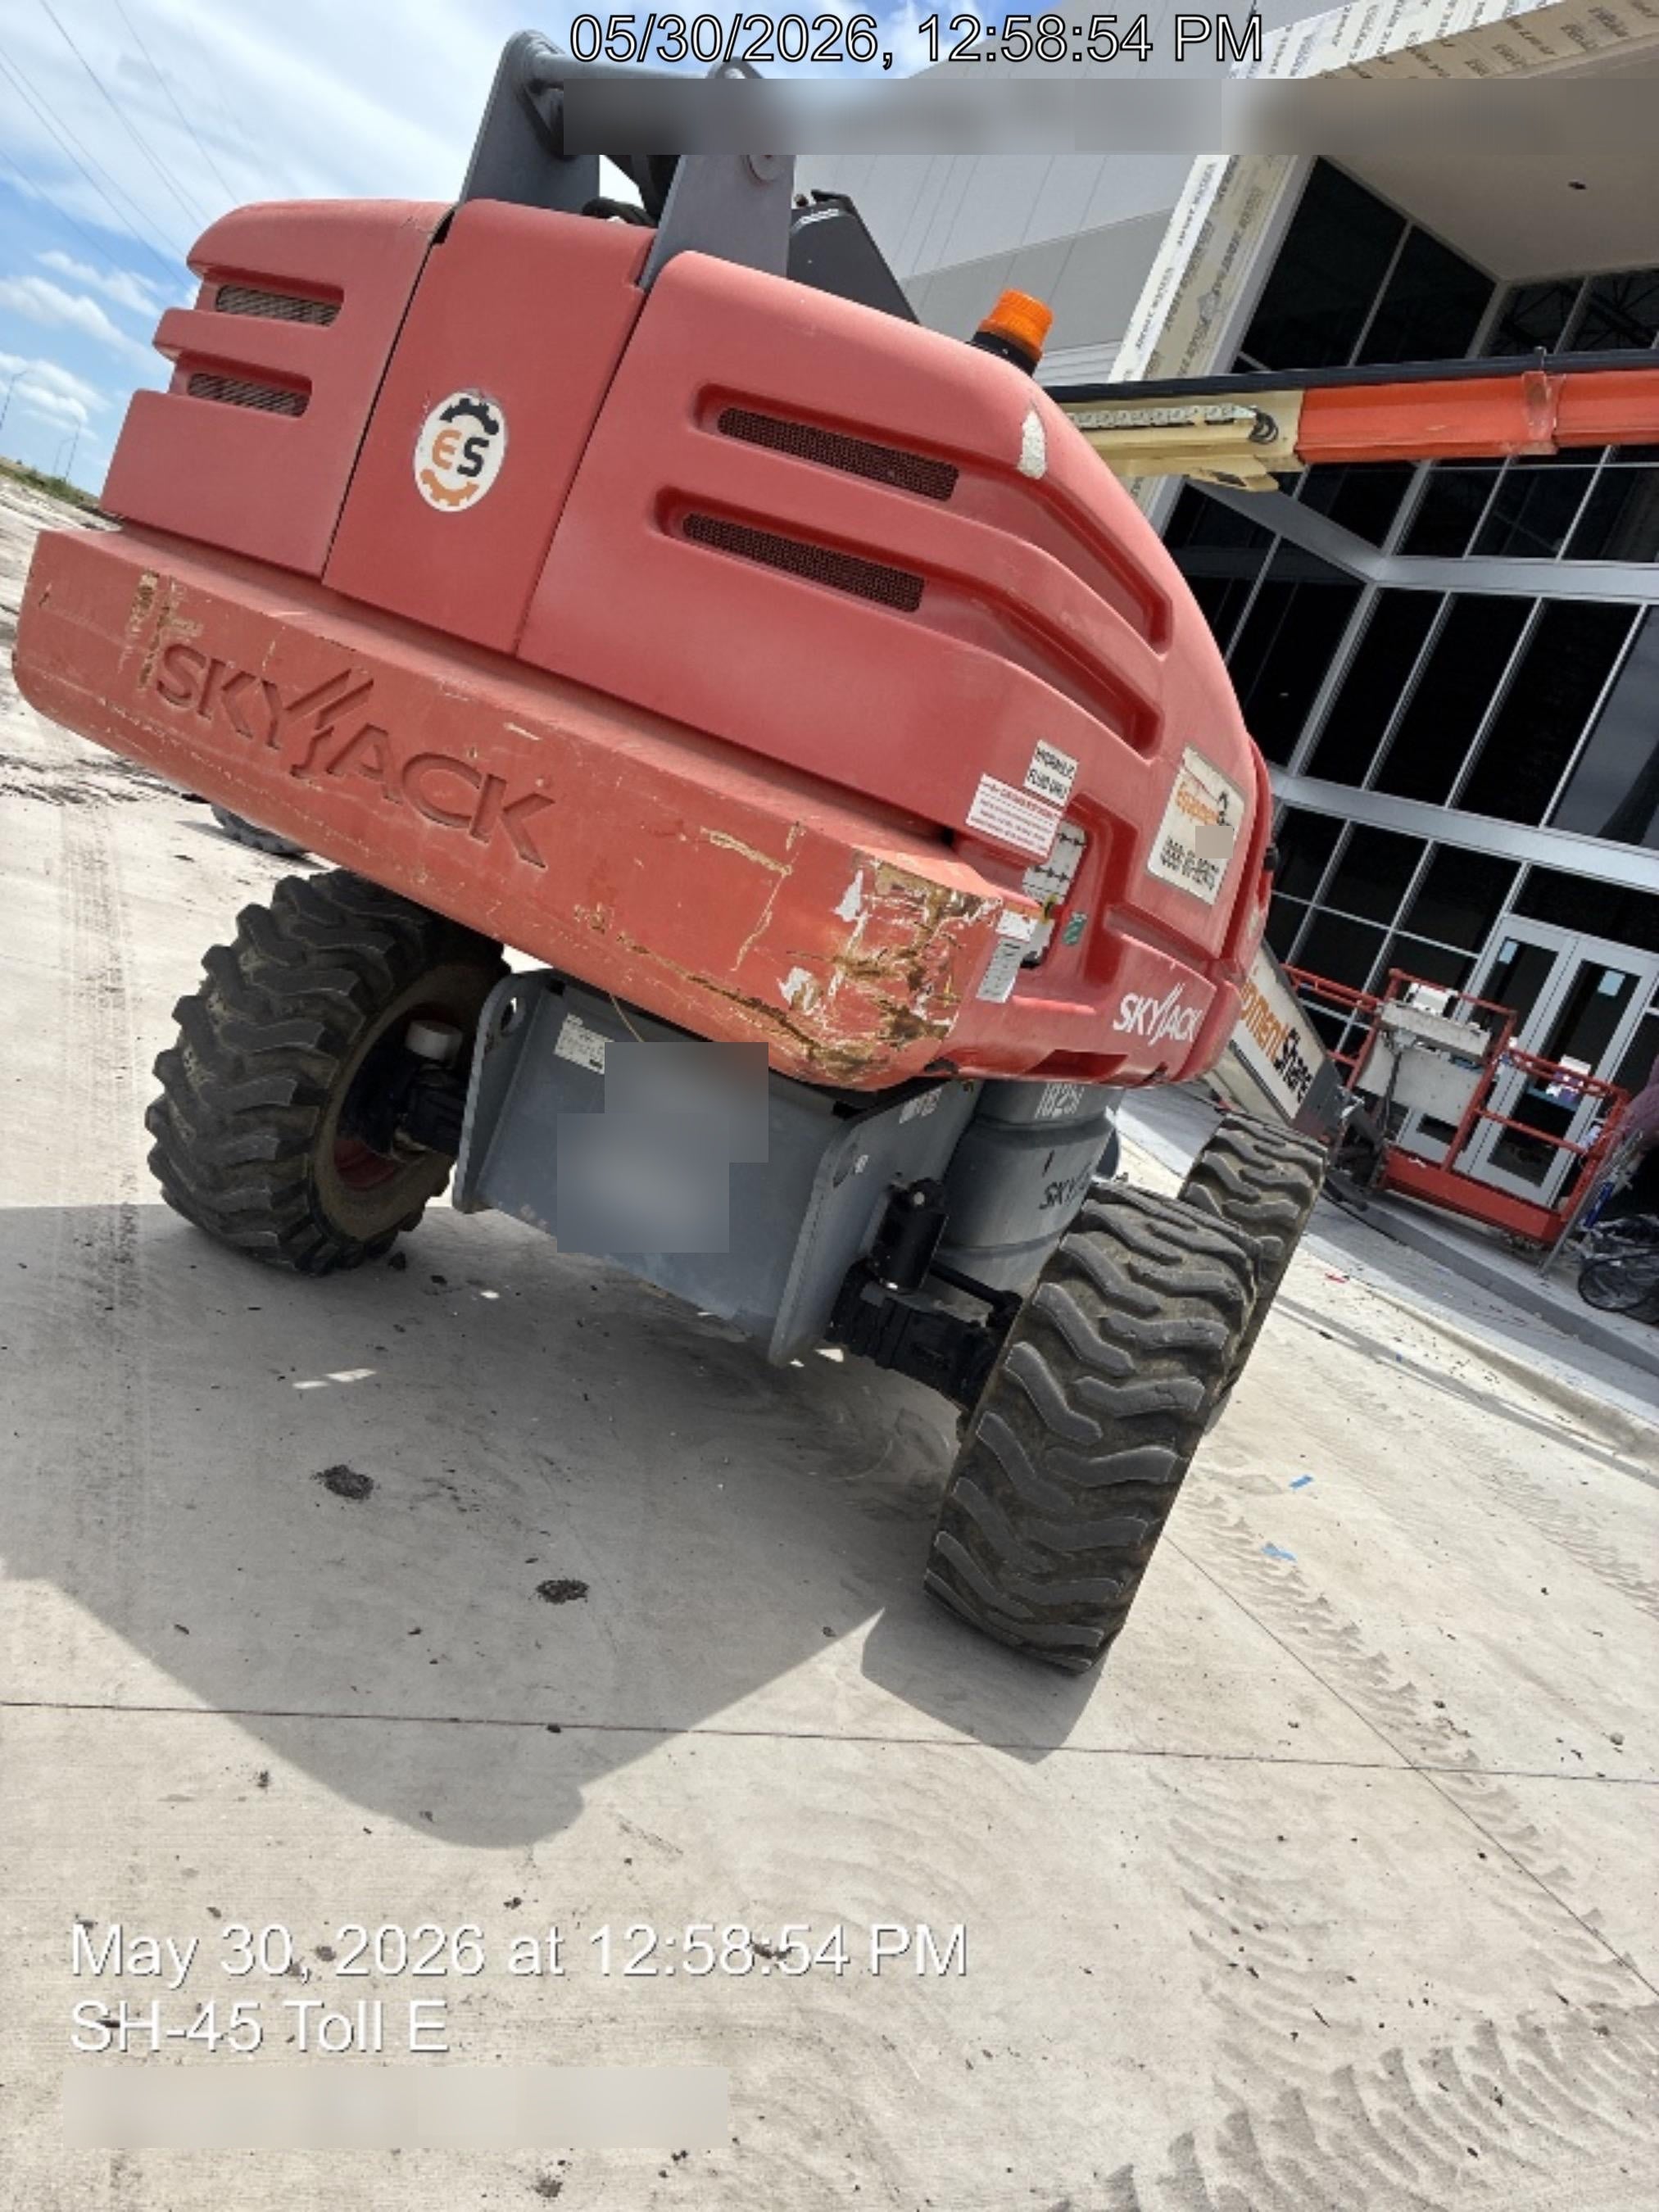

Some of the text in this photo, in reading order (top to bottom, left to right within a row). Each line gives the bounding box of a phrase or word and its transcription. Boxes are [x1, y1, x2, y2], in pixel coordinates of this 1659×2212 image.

[155, 643, 556, 869] SKYJACK
[1113, 982, 1203, 1047] SKYJACK
[1239, 979, 1312, 1104] pmentShare
